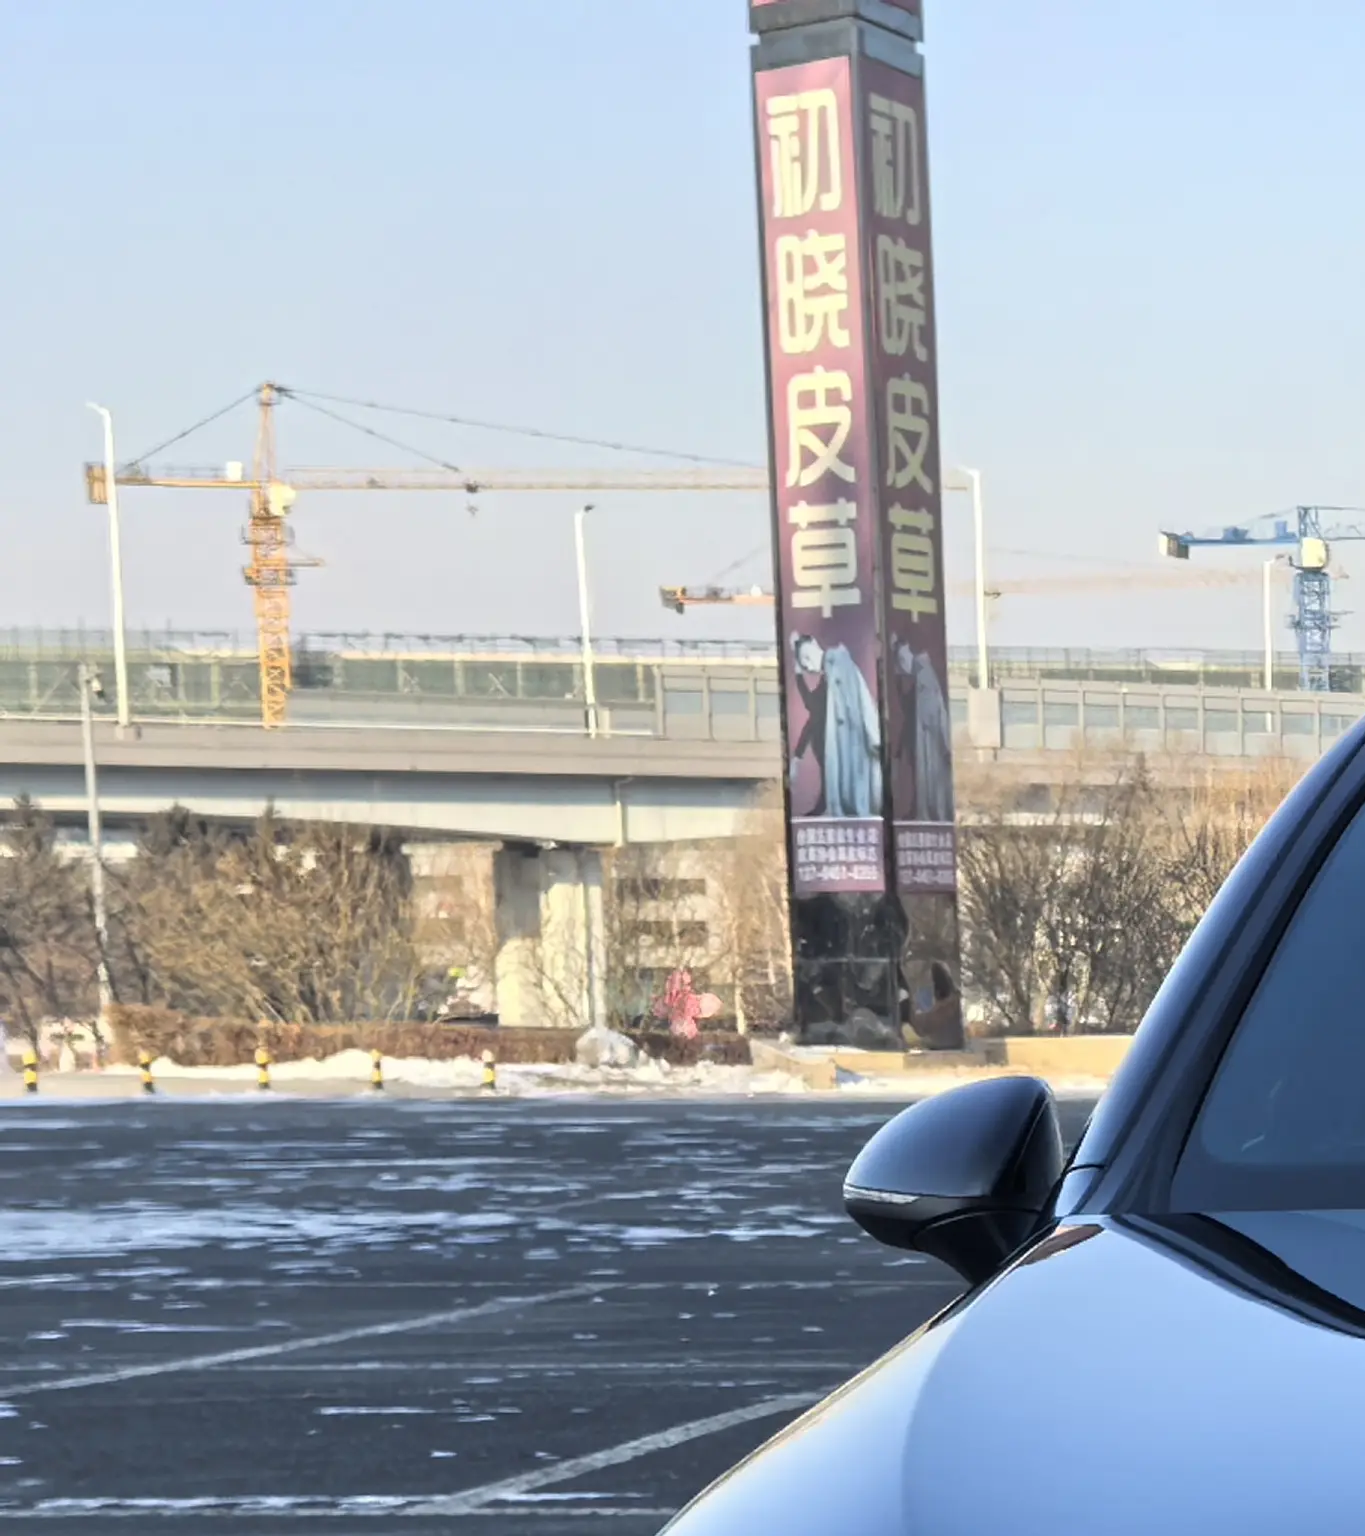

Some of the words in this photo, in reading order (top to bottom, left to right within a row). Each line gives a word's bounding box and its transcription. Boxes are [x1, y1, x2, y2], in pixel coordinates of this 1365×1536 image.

[766, 87, 862, 618] 初晓皮草
[868, 91, 937, 623] 初晓皮草
